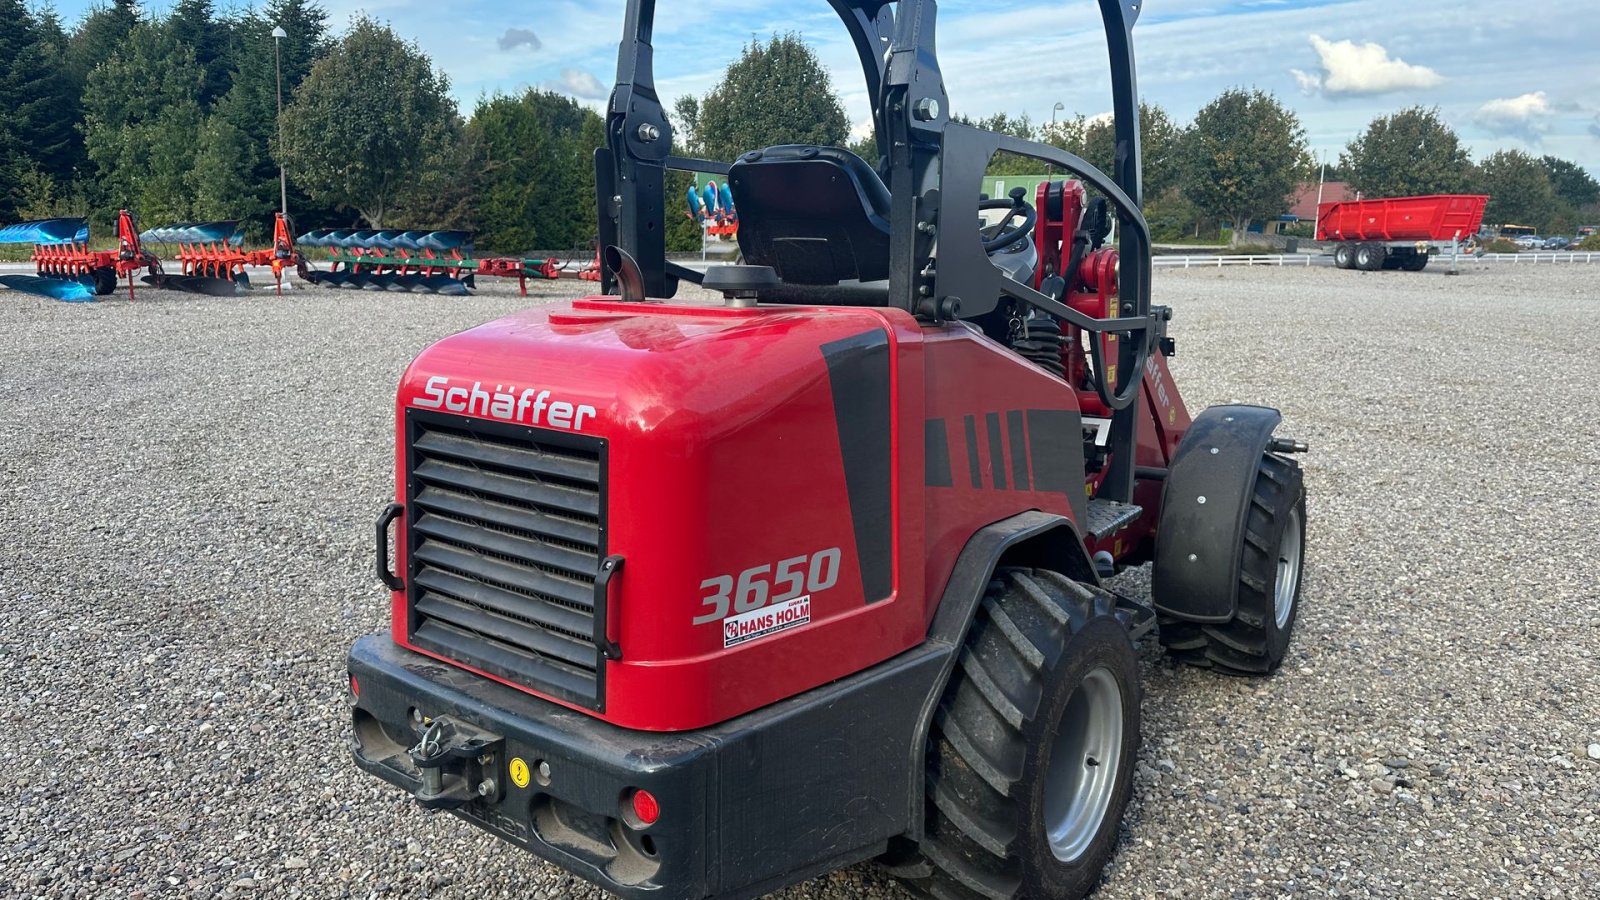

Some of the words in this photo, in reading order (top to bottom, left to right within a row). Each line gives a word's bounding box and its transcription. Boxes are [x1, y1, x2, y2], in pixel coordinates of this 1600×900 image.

[413, 376, 597, 430] Schäffer
[1146, 355, 1169, 407] äffer
[692, 547, 842, 626] 3650
[739, 614, 774, 636] HANS
[776, 603, 809, 625] HOLM
